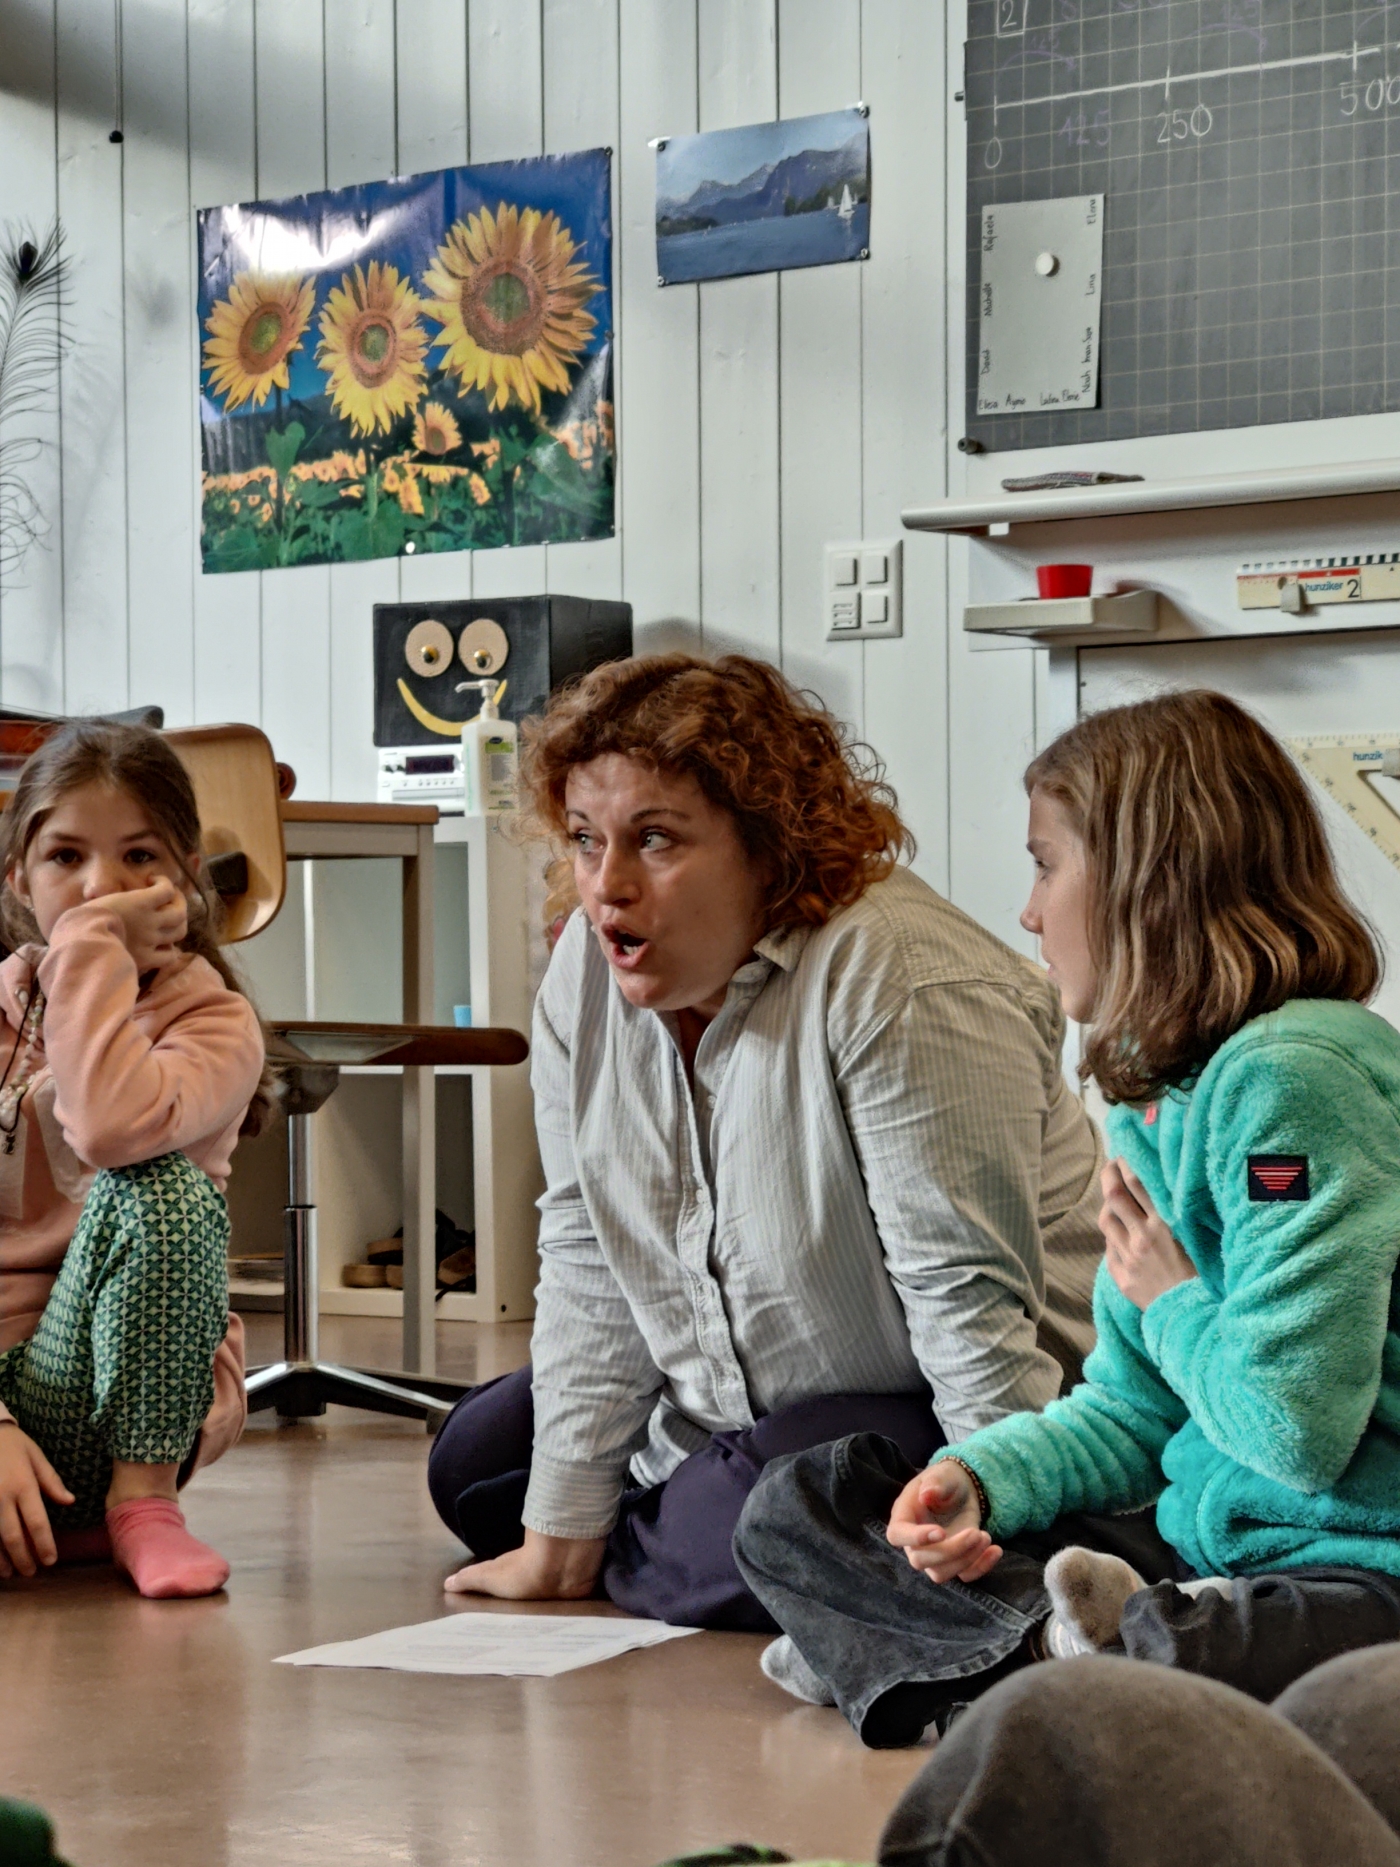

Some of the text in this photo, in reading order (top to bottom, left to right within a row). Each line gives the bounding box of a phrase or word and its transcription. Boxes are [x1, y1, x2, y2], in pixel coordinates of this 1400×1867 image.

[1001, 0, 1018, 28] 2
[1339, 75, 1400, 117] 500
[1058, 110, 1112, 148] 125
[1156, 103, 1213, 144] 250
[984, 136, 1003, 169] 0
[1305, 578, 1360, 599] hunziker 2
